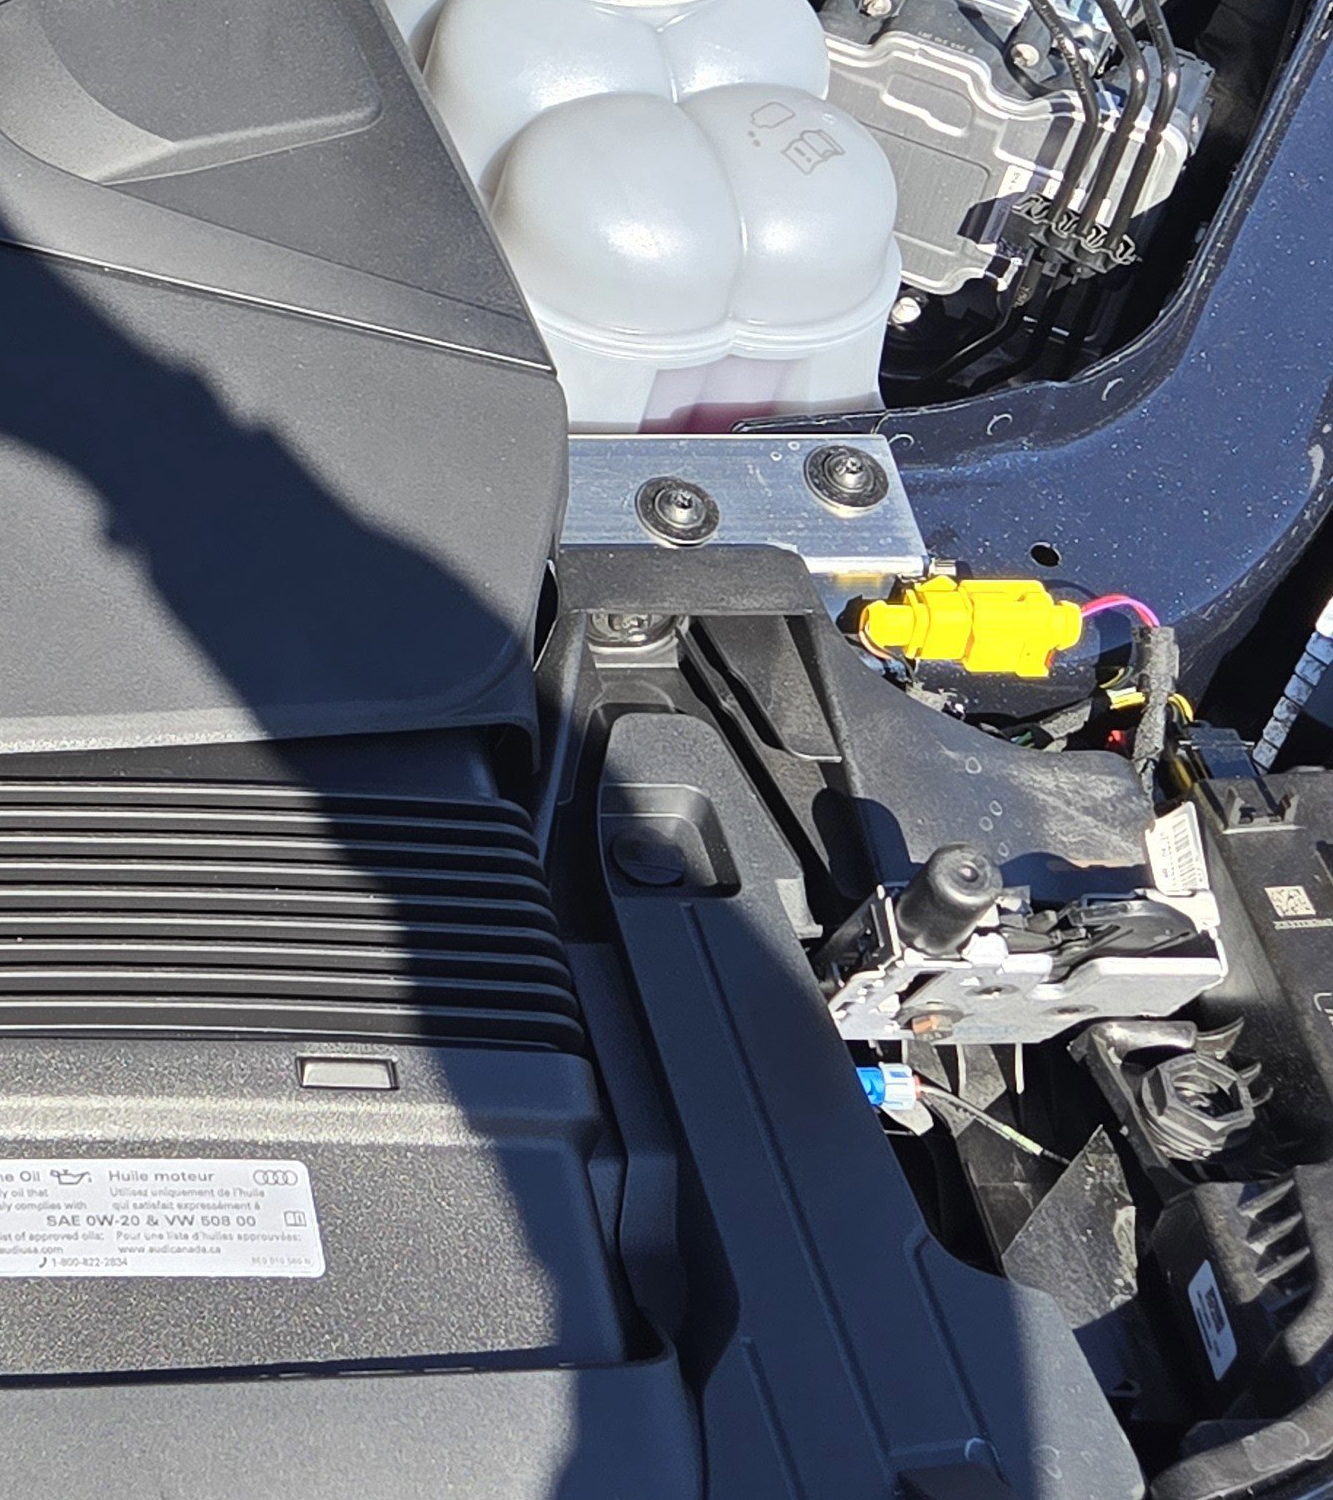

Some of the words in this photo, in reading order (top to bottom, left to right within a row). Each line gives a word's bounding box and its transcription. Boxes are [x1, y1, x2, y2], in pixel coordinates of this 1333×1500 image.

[20, 1171, 40, 1182] Oil
[109, 1171, 148, 1182] Huile
[154, 1172, 214, 1182] moteur
[11, 1189, 24, 1197] oil
[27, 1188, 48, 1197] that
[151, 1188, 215, 1198] uniquement
[217, 1188, 230, 1197] de
[233, 1187, 265, 1197] l'huile
[15, 1203, 61, 1211] complies
[112, 1202, 129, 1211] qui
[132, 1201, 174, 1210] satisfait
[46, 1215, 81, 1226] SAE
[86, 1214, 140, 1226] 0W-20
[146, 1215, 159, 1226] &
[165, 1214, 195, 1226] VW
[201, 1215, 231, 1227] 508
[236, 1215, 256, 1227] 00
[15, 1232, 25, 1241] of
[29, 1232, 78, 1242] approved
[81, 1232, 104, 1240] oils:
[117, 1232, 140, 1240] Pour
[167, 1232, 188, 1240] liste
[118, 1246, 221, 1254] www.audicanada.ca
